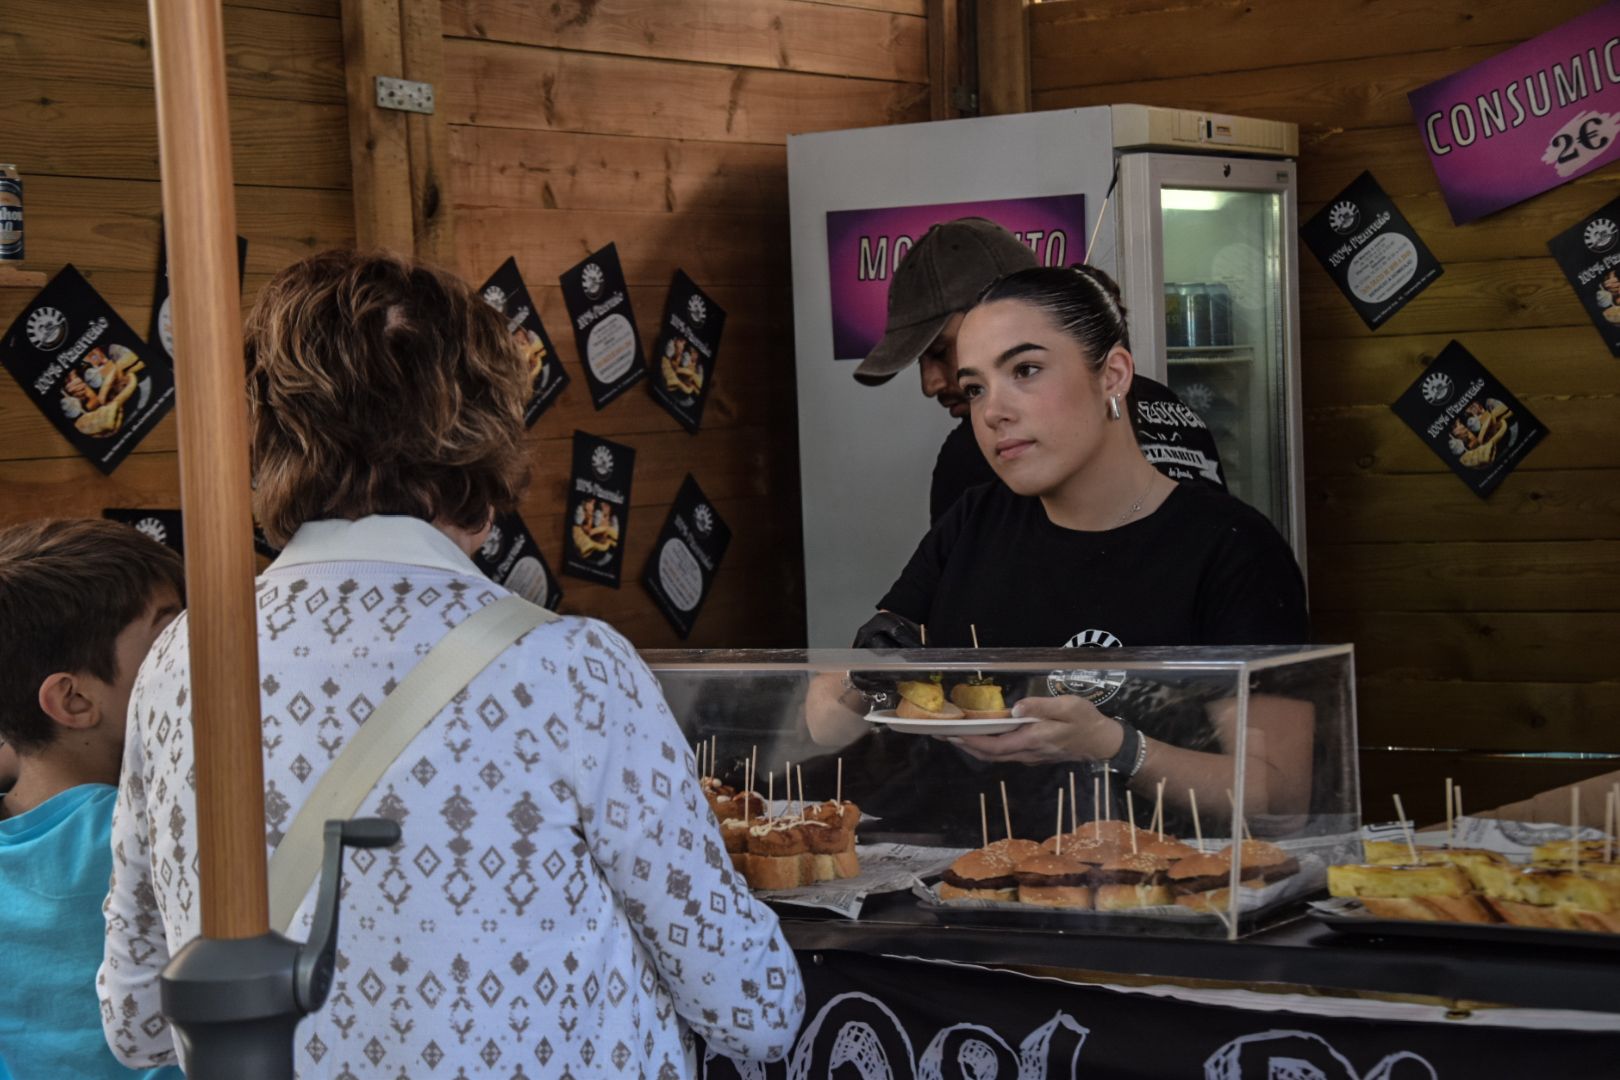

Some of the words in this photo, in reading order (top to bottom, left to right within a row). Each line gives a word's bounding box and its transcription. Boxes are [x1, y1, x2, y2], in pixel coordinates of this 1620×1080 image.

[1552, 118, 1609, 164] 2€
[1328, 243, 1352, 267] 100%
[1427, 414, 1451, 438] 100%
